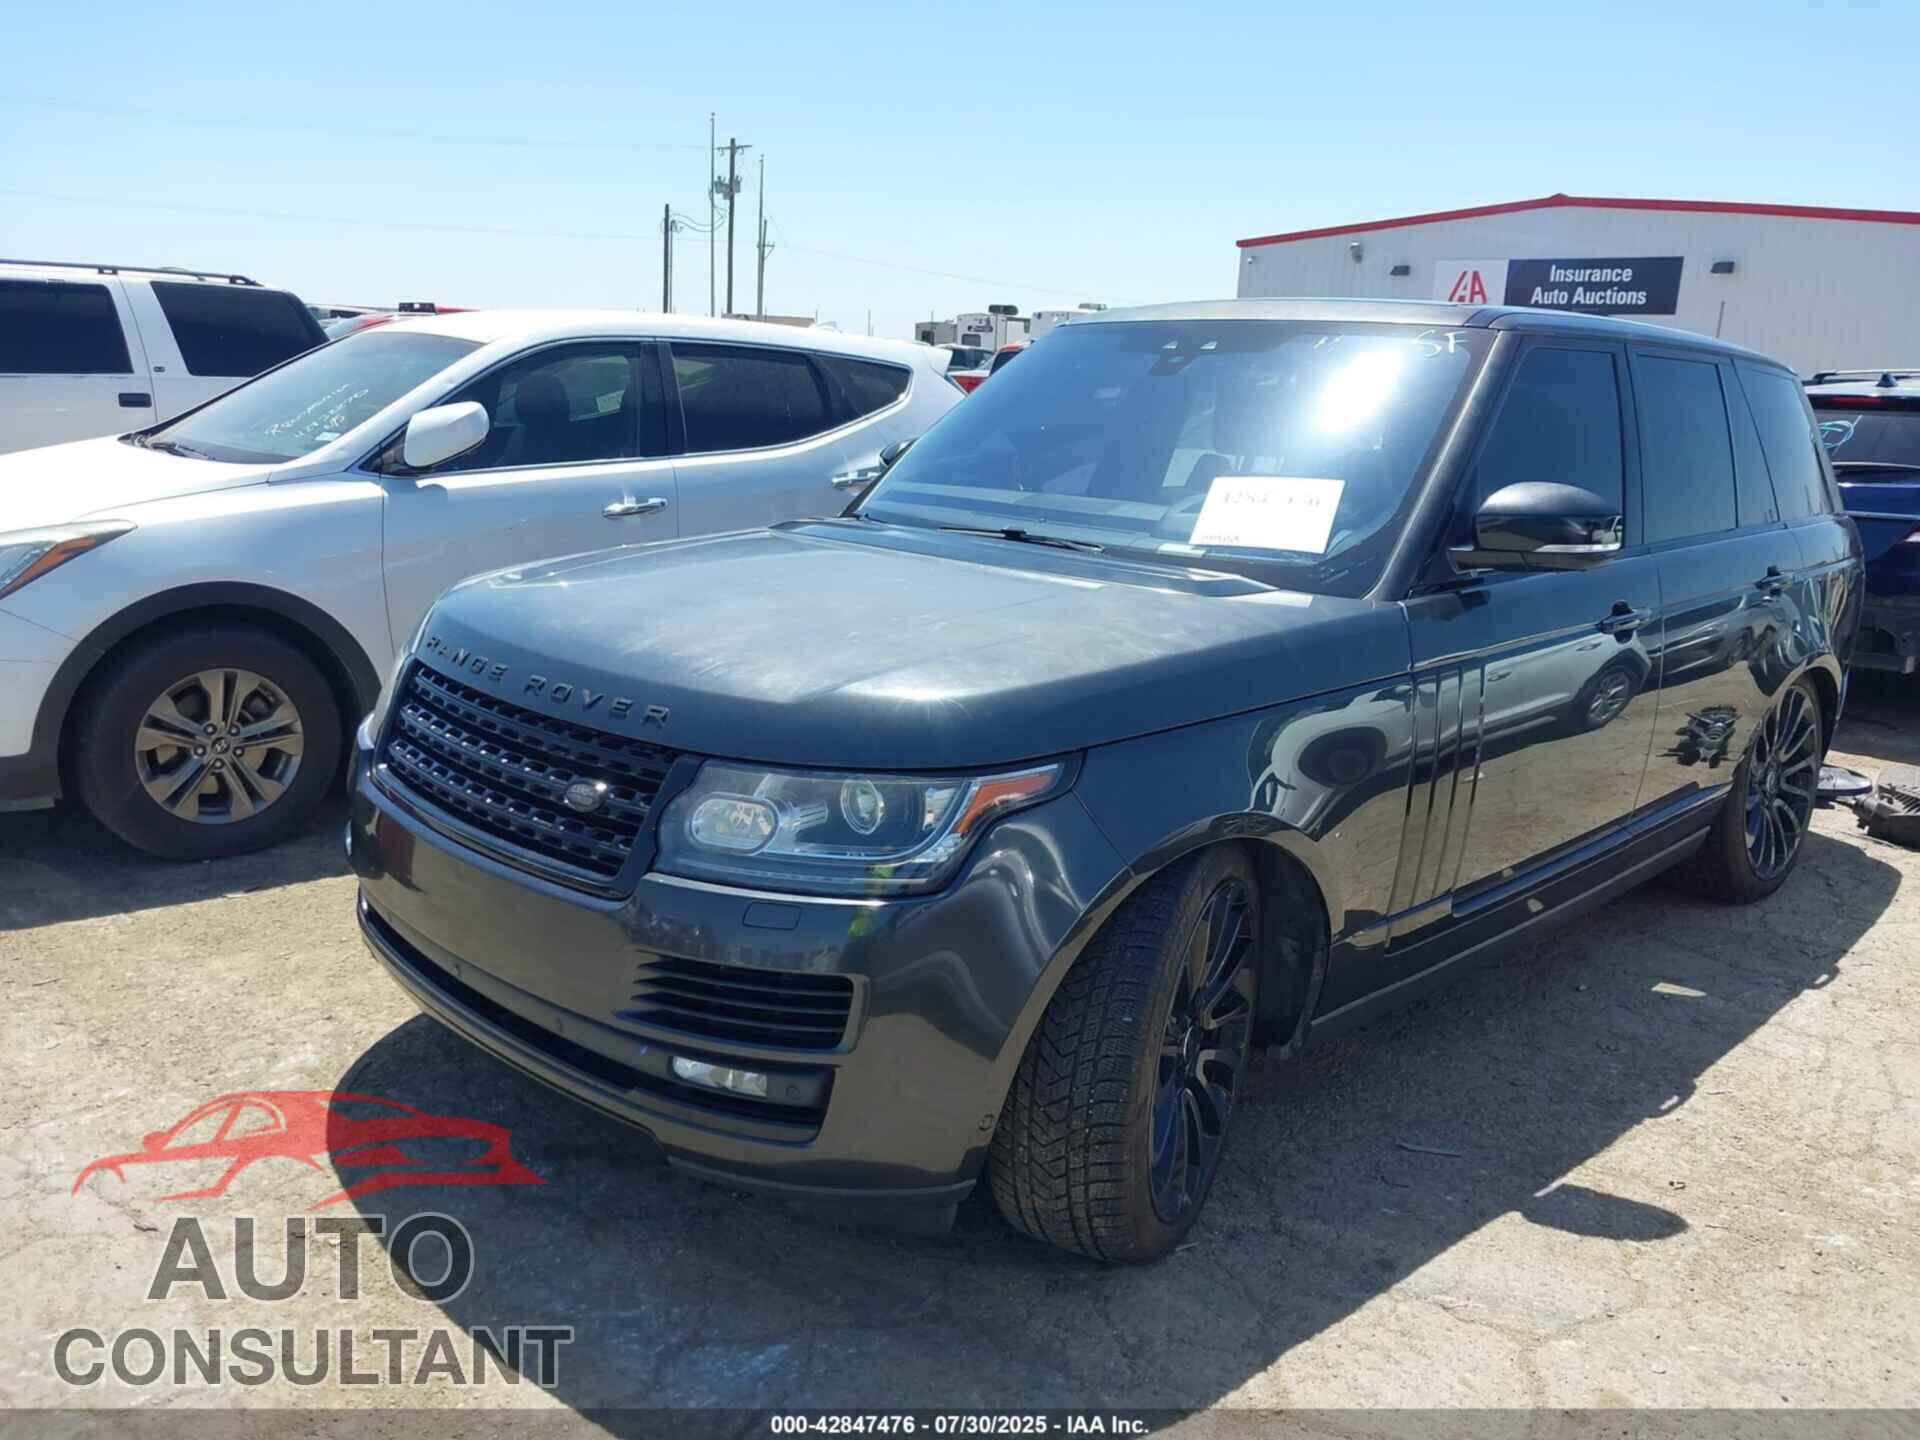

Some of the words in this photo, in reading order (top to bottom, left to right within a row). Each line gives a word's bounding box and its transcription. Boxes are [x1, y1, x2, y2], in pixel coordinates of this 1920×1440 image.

[1549, 264, 1633, 283] Insurance
[1530, 286, 1568, 305] Auto
[1571, 286, 1647, 306] Auctions
[426, 636, 509, 682] RANGE
[522, 673, 672, 729] ROVER
